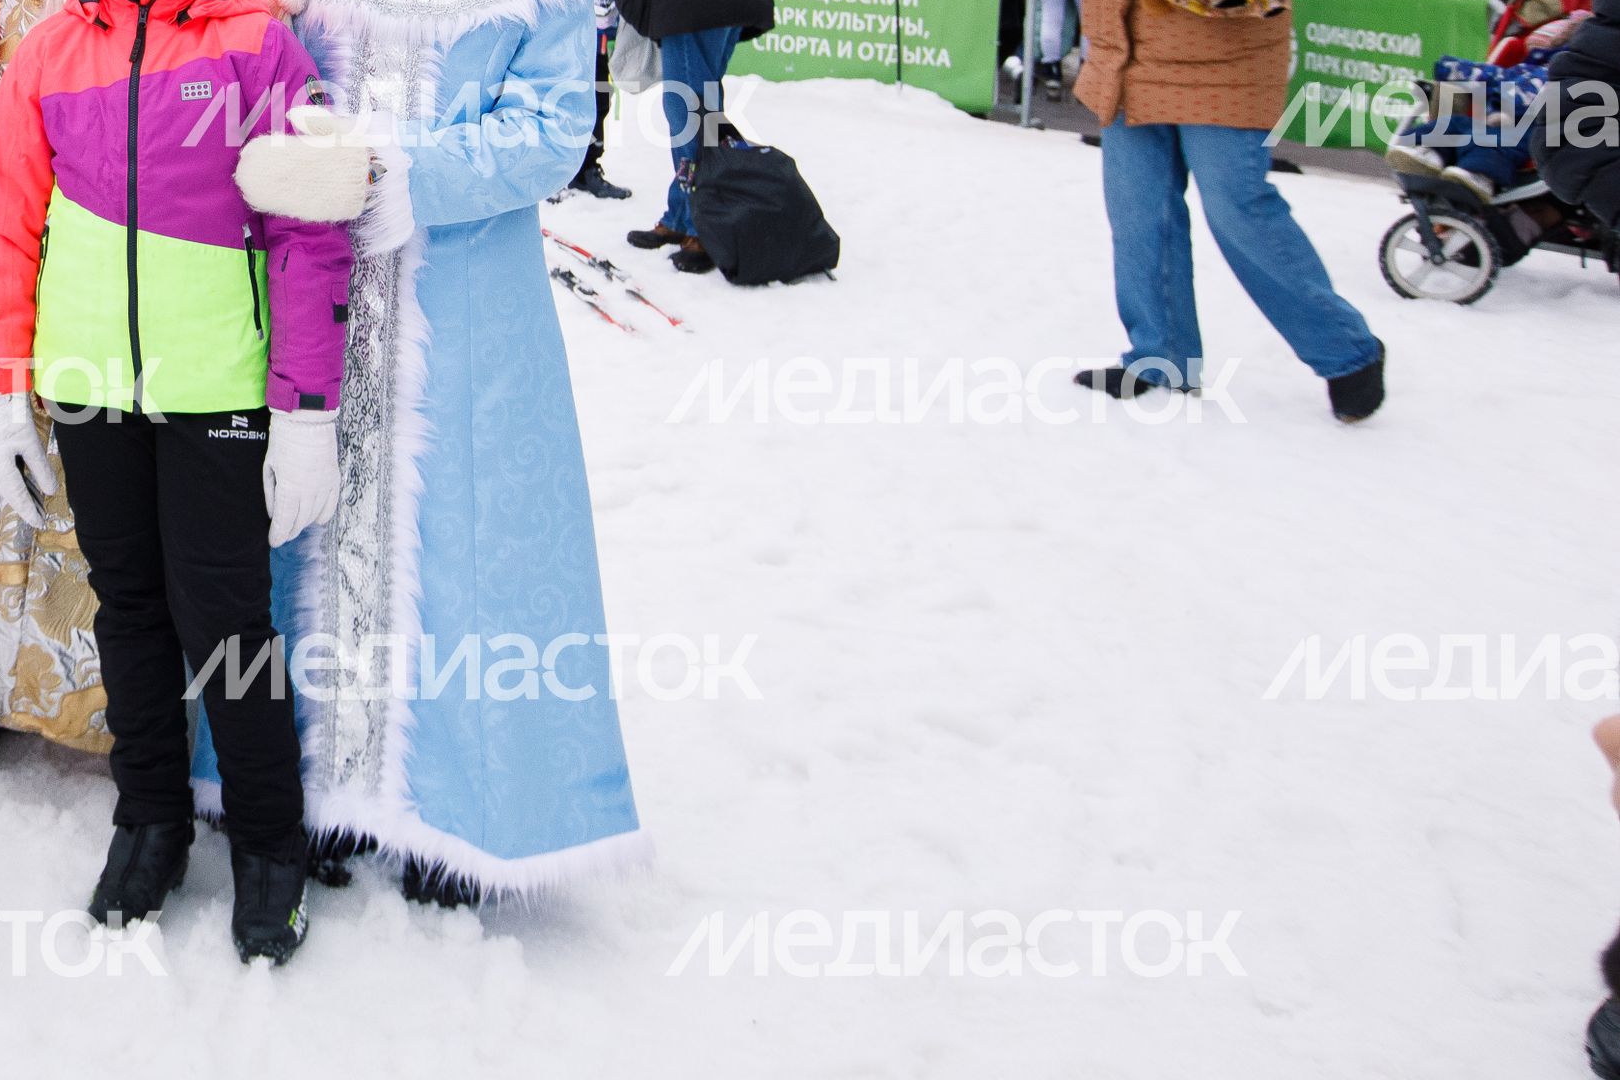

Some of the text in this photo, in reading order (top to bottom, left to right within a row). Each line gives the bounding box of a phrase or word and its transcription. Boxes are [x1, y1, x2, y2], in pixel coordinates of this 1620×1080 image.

[773, 6, 931, 39] АРК КУЛЬТУРЫ,
[1304, 21, 1422, 58] ОДИНЦОВСКИЙ
[752, 32, 952, 68] СПОРТА И ОТДЫХА
[208, 428, 267, 441] NORDSKI
